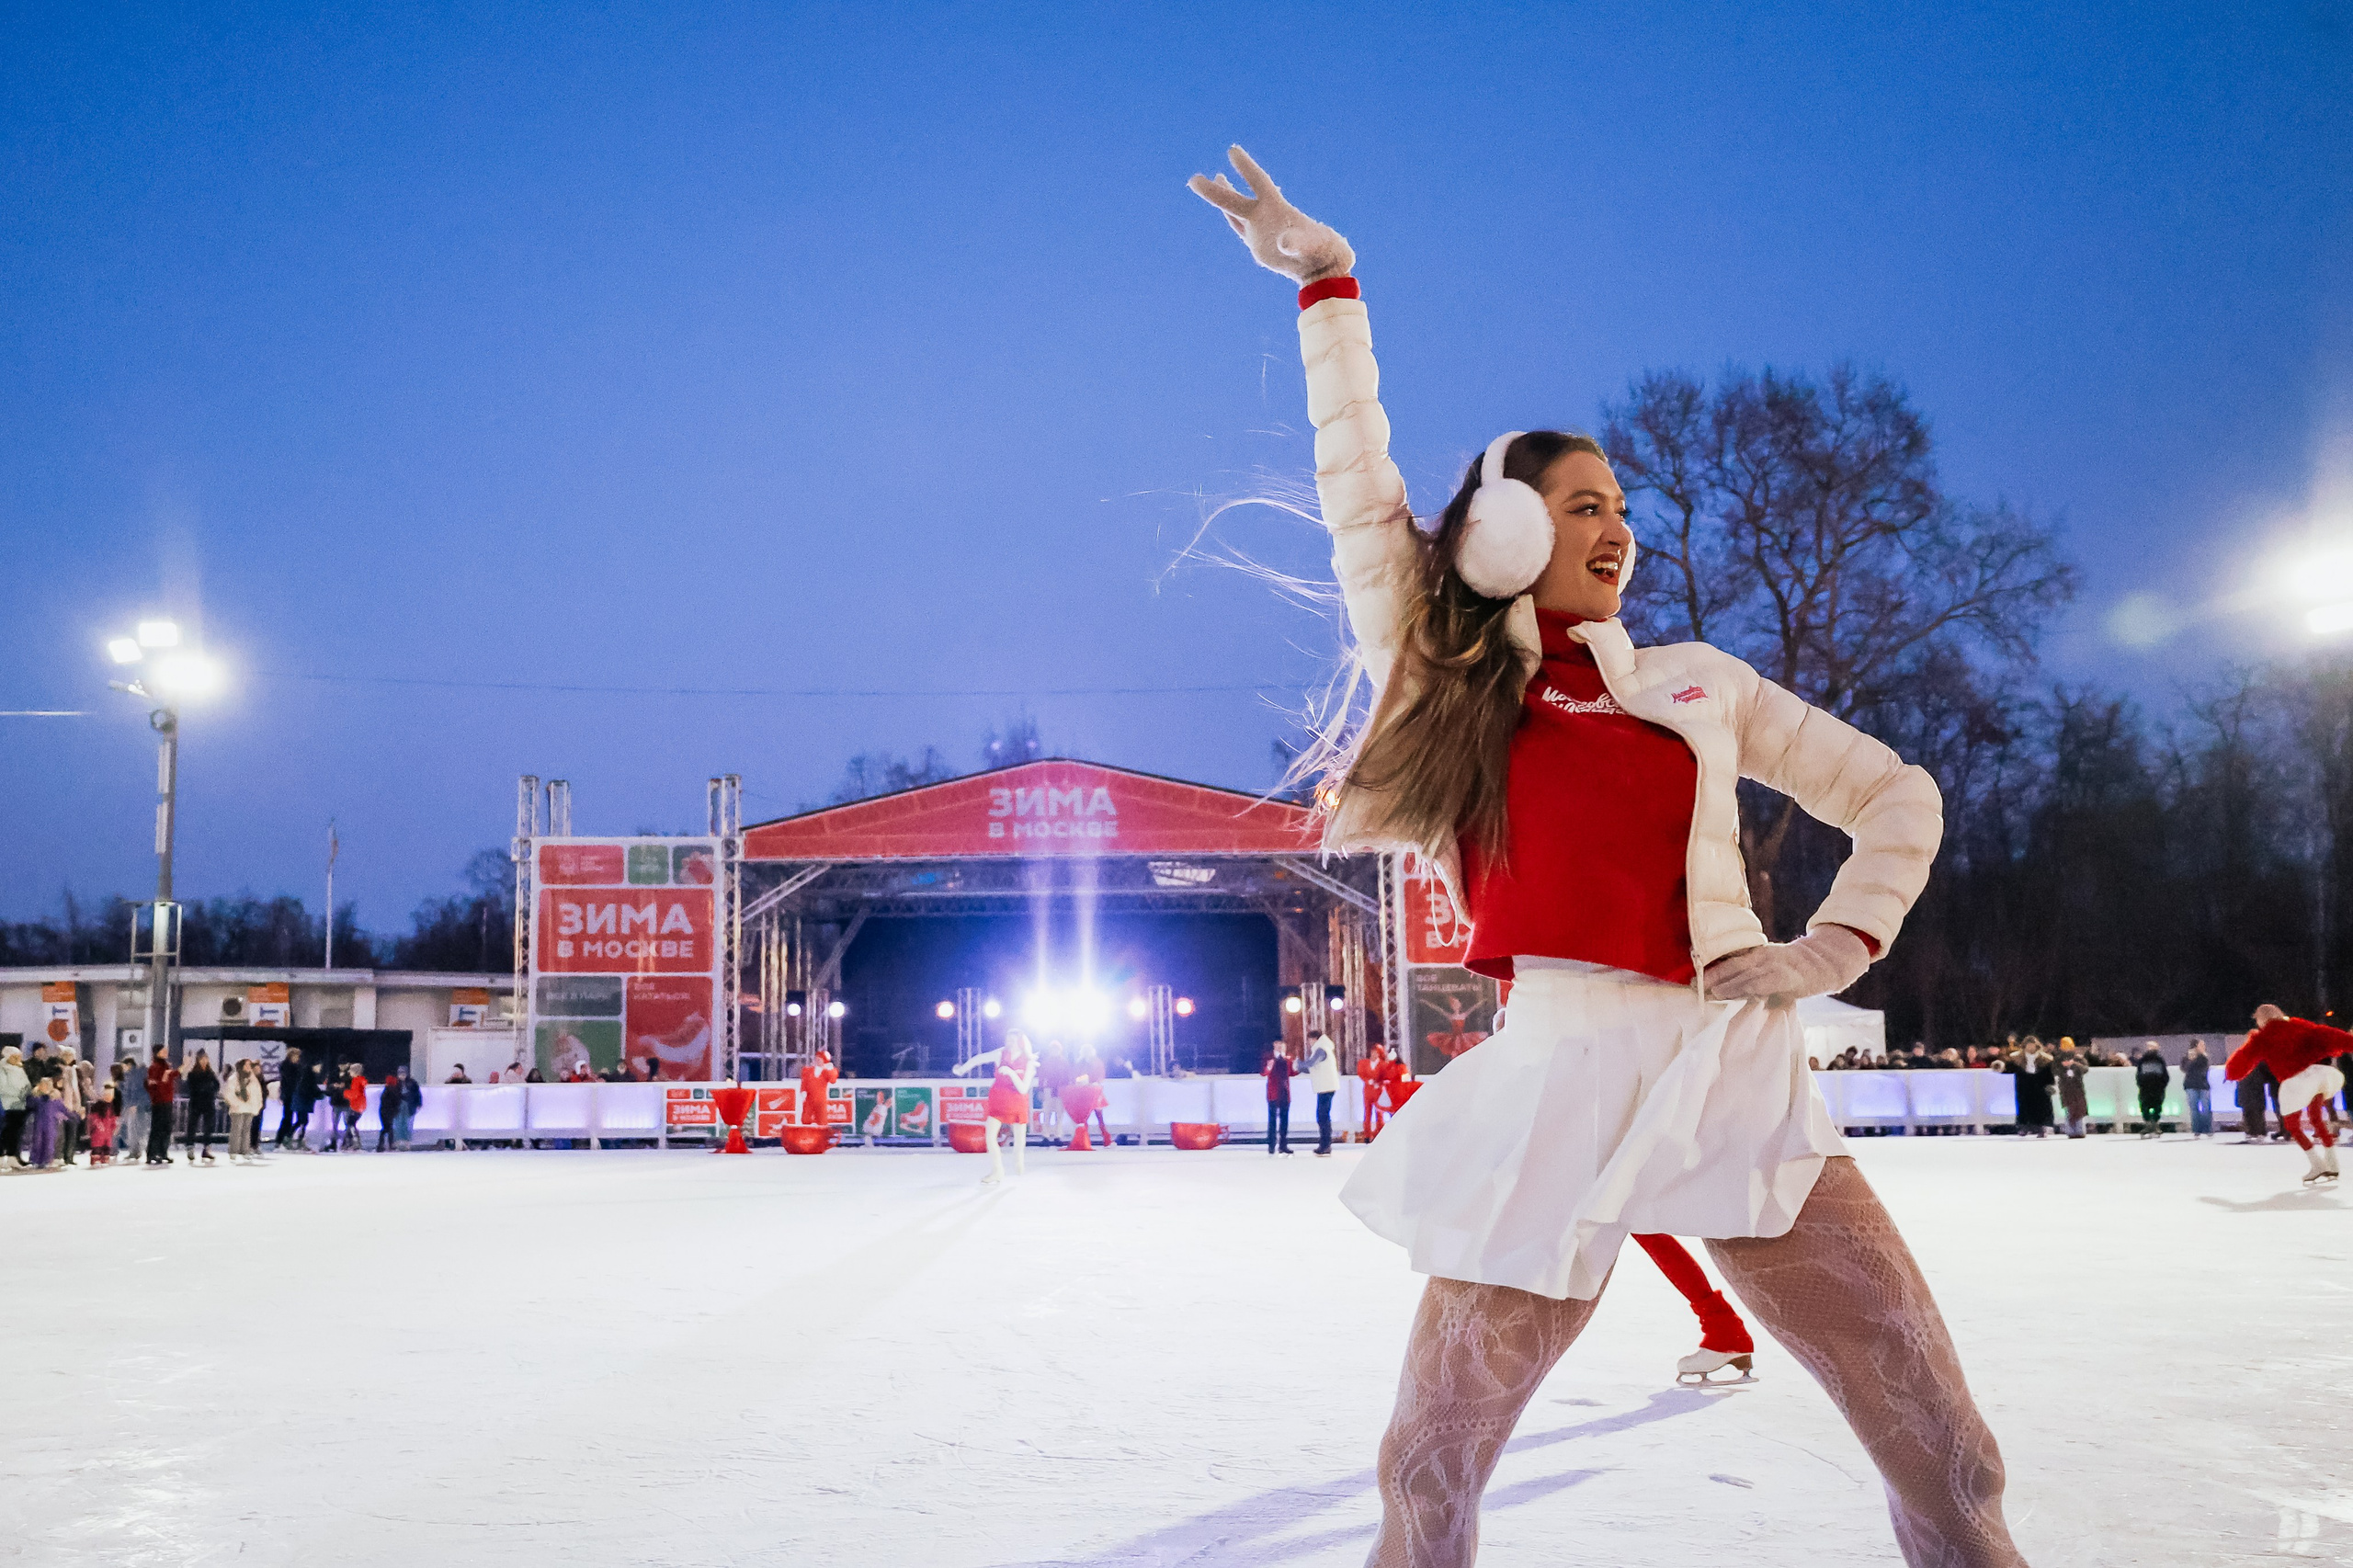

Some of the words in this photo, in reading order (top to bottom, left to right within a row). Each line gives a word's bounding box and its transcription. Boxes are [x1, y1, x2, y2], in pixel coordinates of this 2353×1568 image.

[988, 787, 1118, 817] ЗИМА
[988, 822, 1005, 838] В
[1013, 821, 1119, 838] МОСКВЕ
[558, 903, 694, 935] ЗИМА
[557, 939, 574, 958] В
[583, 939, 694, 959] МОСКВЕ
